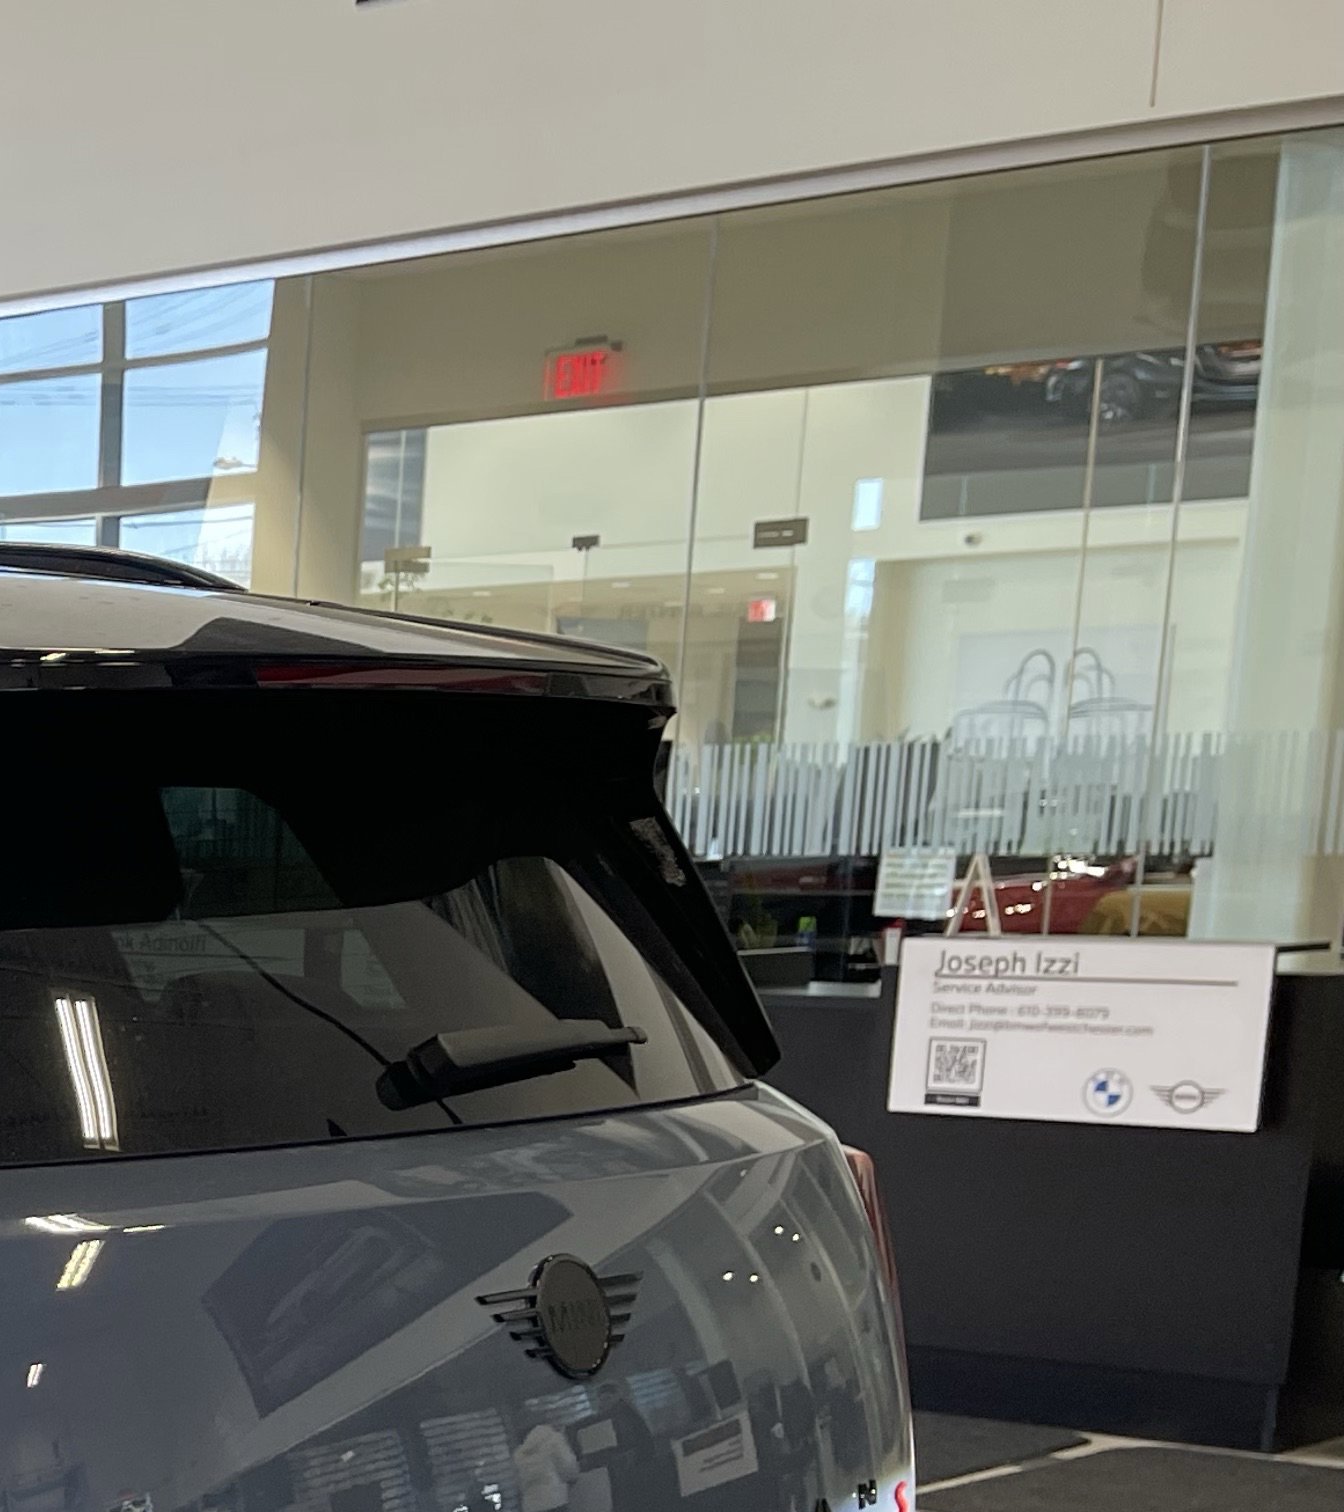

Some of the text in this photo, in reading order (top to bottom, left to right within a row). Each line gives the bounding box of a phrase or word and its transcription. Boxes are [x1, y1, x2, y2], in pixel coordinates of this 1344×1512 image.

[554, 350, 608, 398] EXIT
[935, 950, 1081, 978] Joseph Izzi
[933, 981, 1038, 996] Service Advisor
[931, 1003, 965, 1015] Direct
[969, 1004, 1008, 1016] Phone
